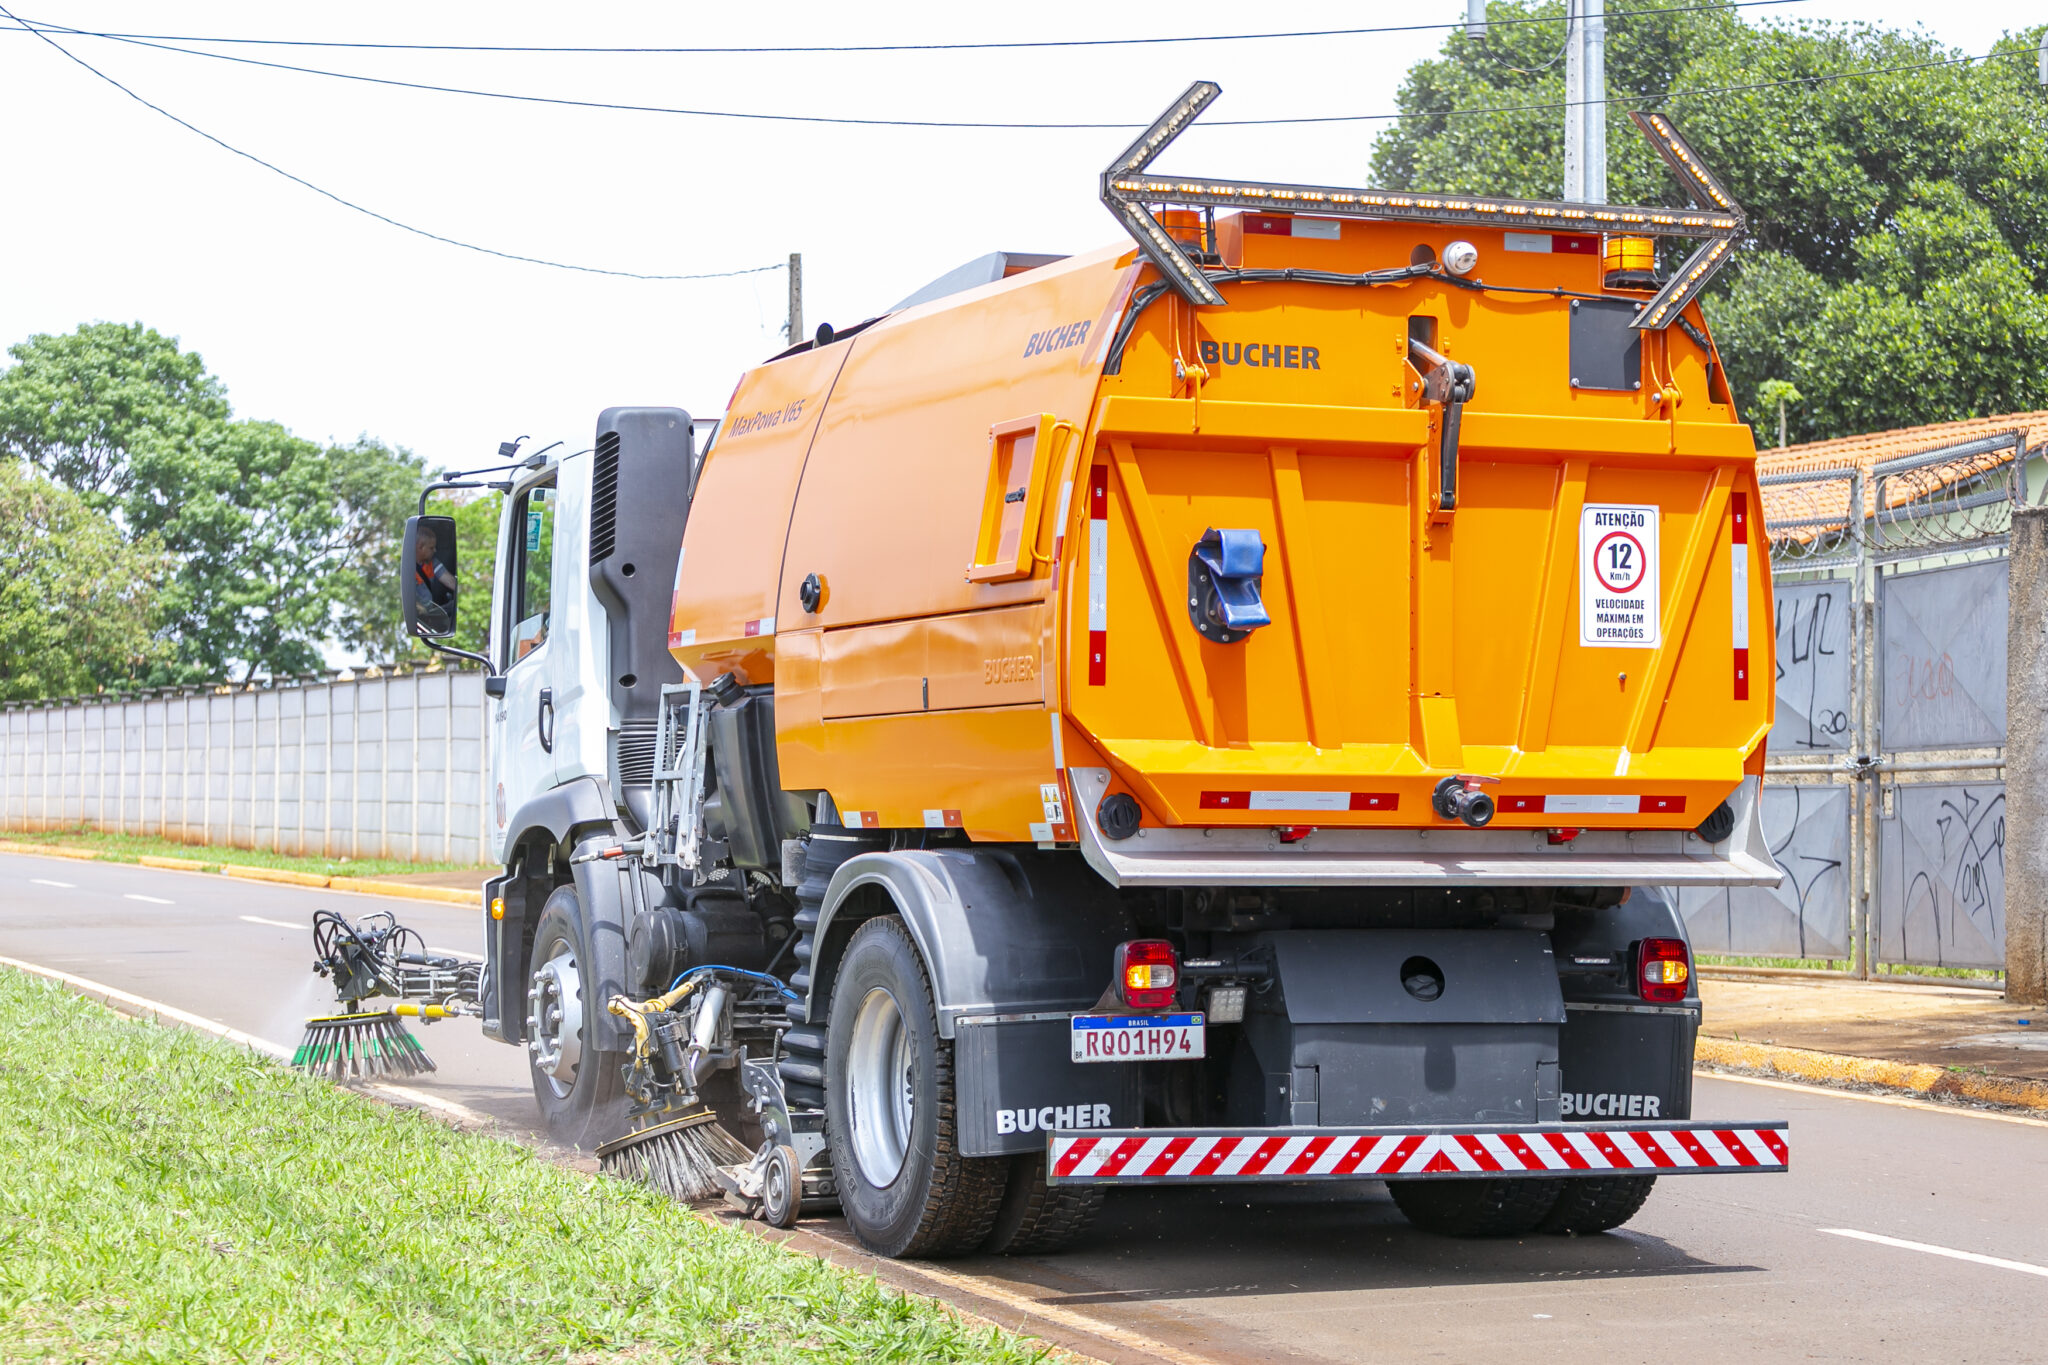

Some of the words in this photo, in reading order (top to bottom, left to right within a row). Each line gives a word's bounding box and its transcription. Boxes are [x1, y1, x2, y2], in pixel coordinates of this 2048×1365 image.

[1023, 320, 1091, 358] BUCHER
[1200, 340, 1321, 370] BUCHER
[728, 410, 782, 438] MaxPowa
[782, 398, 806, 424] V65
[1595, 510, 1645, 529] ATENÇÃO
[1608, 543, 1632, 569] 12
[1609, 571, 1631, 581] Km/h
[1595, 598, 1645, 610] VELOCIDADE
[1596, 611, 1631, 624] MÁXIMA
[1632, 614, 1644, 624] EM
[1596, 626, 1644, 639] OPERAÇÕES
[983, 655, 1034, 685] BUCHER
[1559, 1093, 1660, 1117] BUCHER
[996, 1104, 1111, 1134] BUCHER
